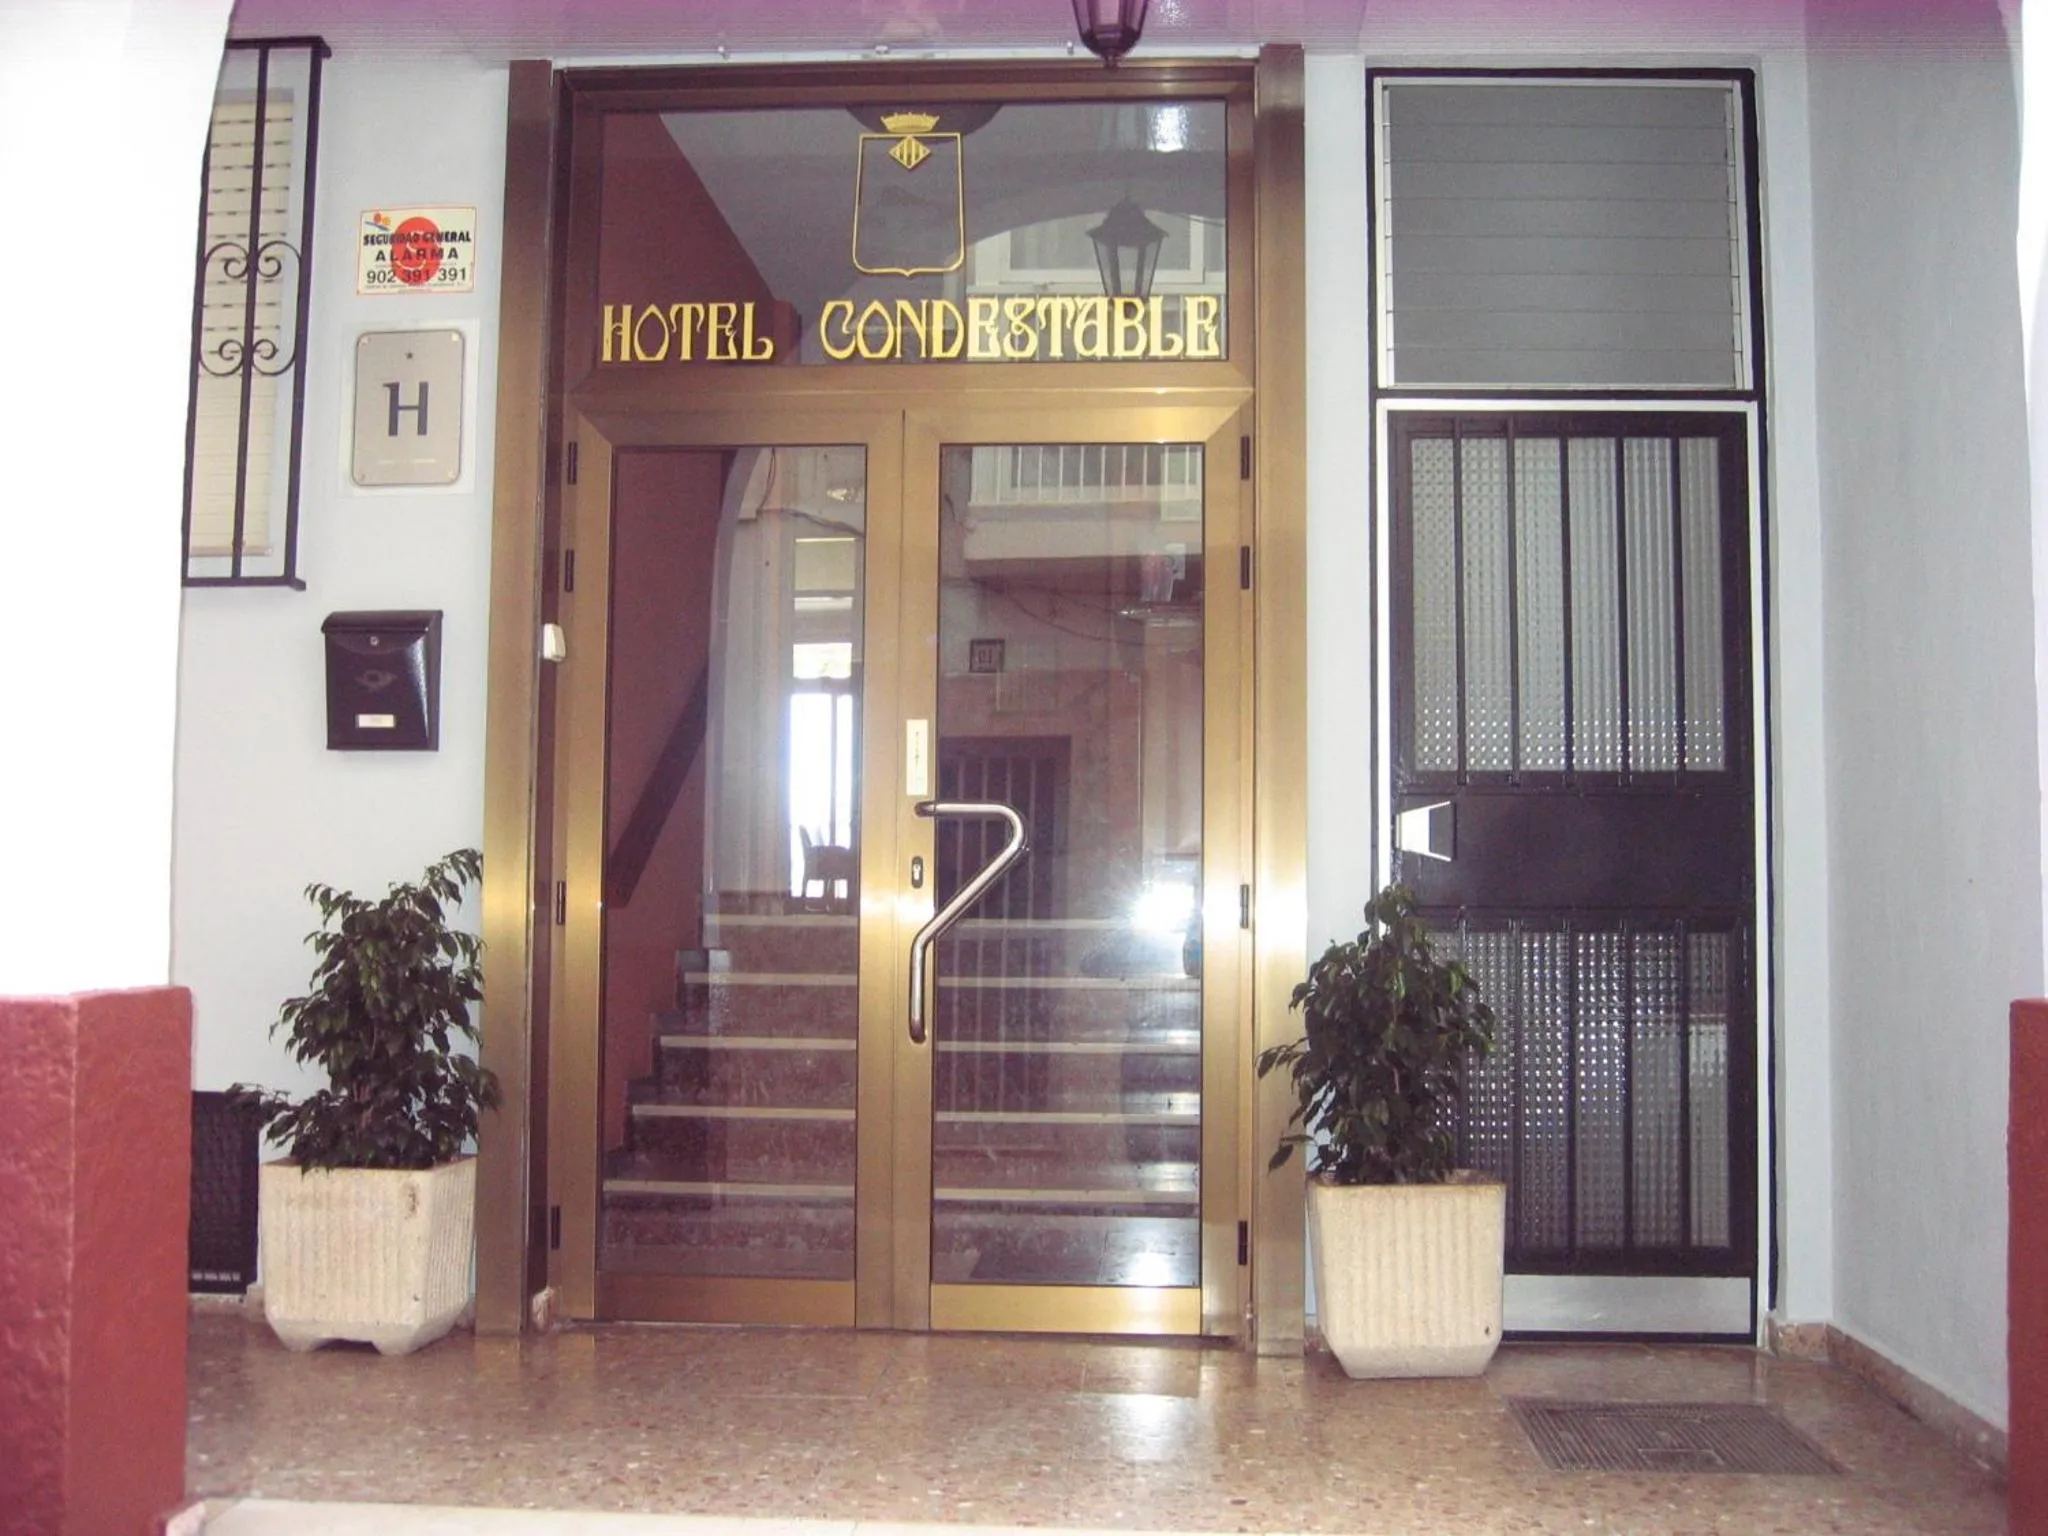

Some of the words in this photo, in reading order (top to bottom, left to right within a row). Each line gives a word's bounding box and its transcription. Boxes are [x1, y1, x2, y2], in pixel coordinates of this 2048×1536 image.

[363, 232, 420, 246] SEGURIDAD
[422, 231, 471, 243] GENERAL
[375, 247, 459, 262] ALARMA
[366, 269, 396, 284] 902
[405, 268, 430, 283] 391
[438, 267, 466, 282] 391
[602, 301, 774, 362] HOTEL
[820, 295, 1220, 360] CONDESTABLE
[383, 381, 429, 437] H
